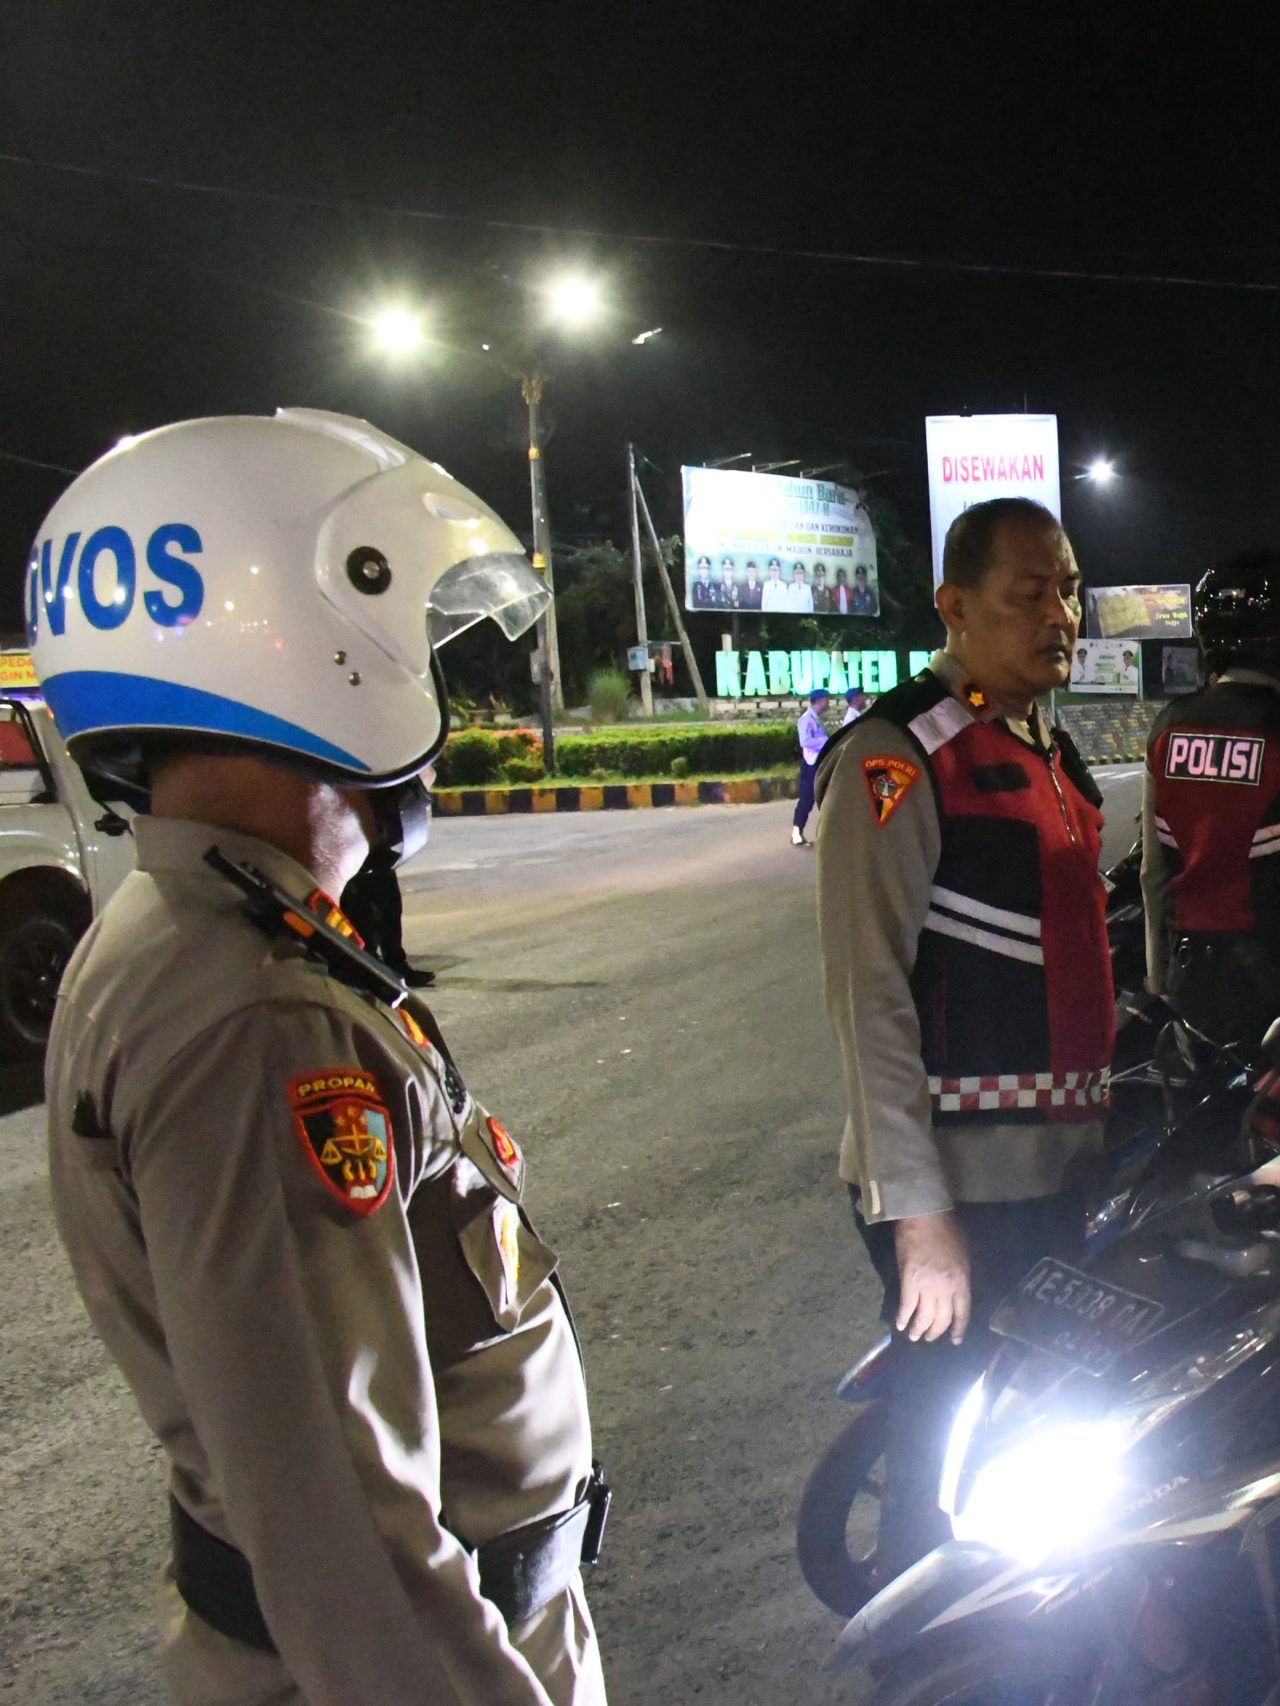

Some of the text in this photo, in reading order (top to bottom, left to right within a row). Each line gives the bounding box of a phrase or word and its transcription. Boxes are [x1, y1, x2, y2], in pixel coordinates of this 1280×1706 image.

[942, 455, 1044, 483] DISEWAKAN
[715, 650, 898, 697] KABUPATEN
[1169, 738, 1259, 780] POLISI
